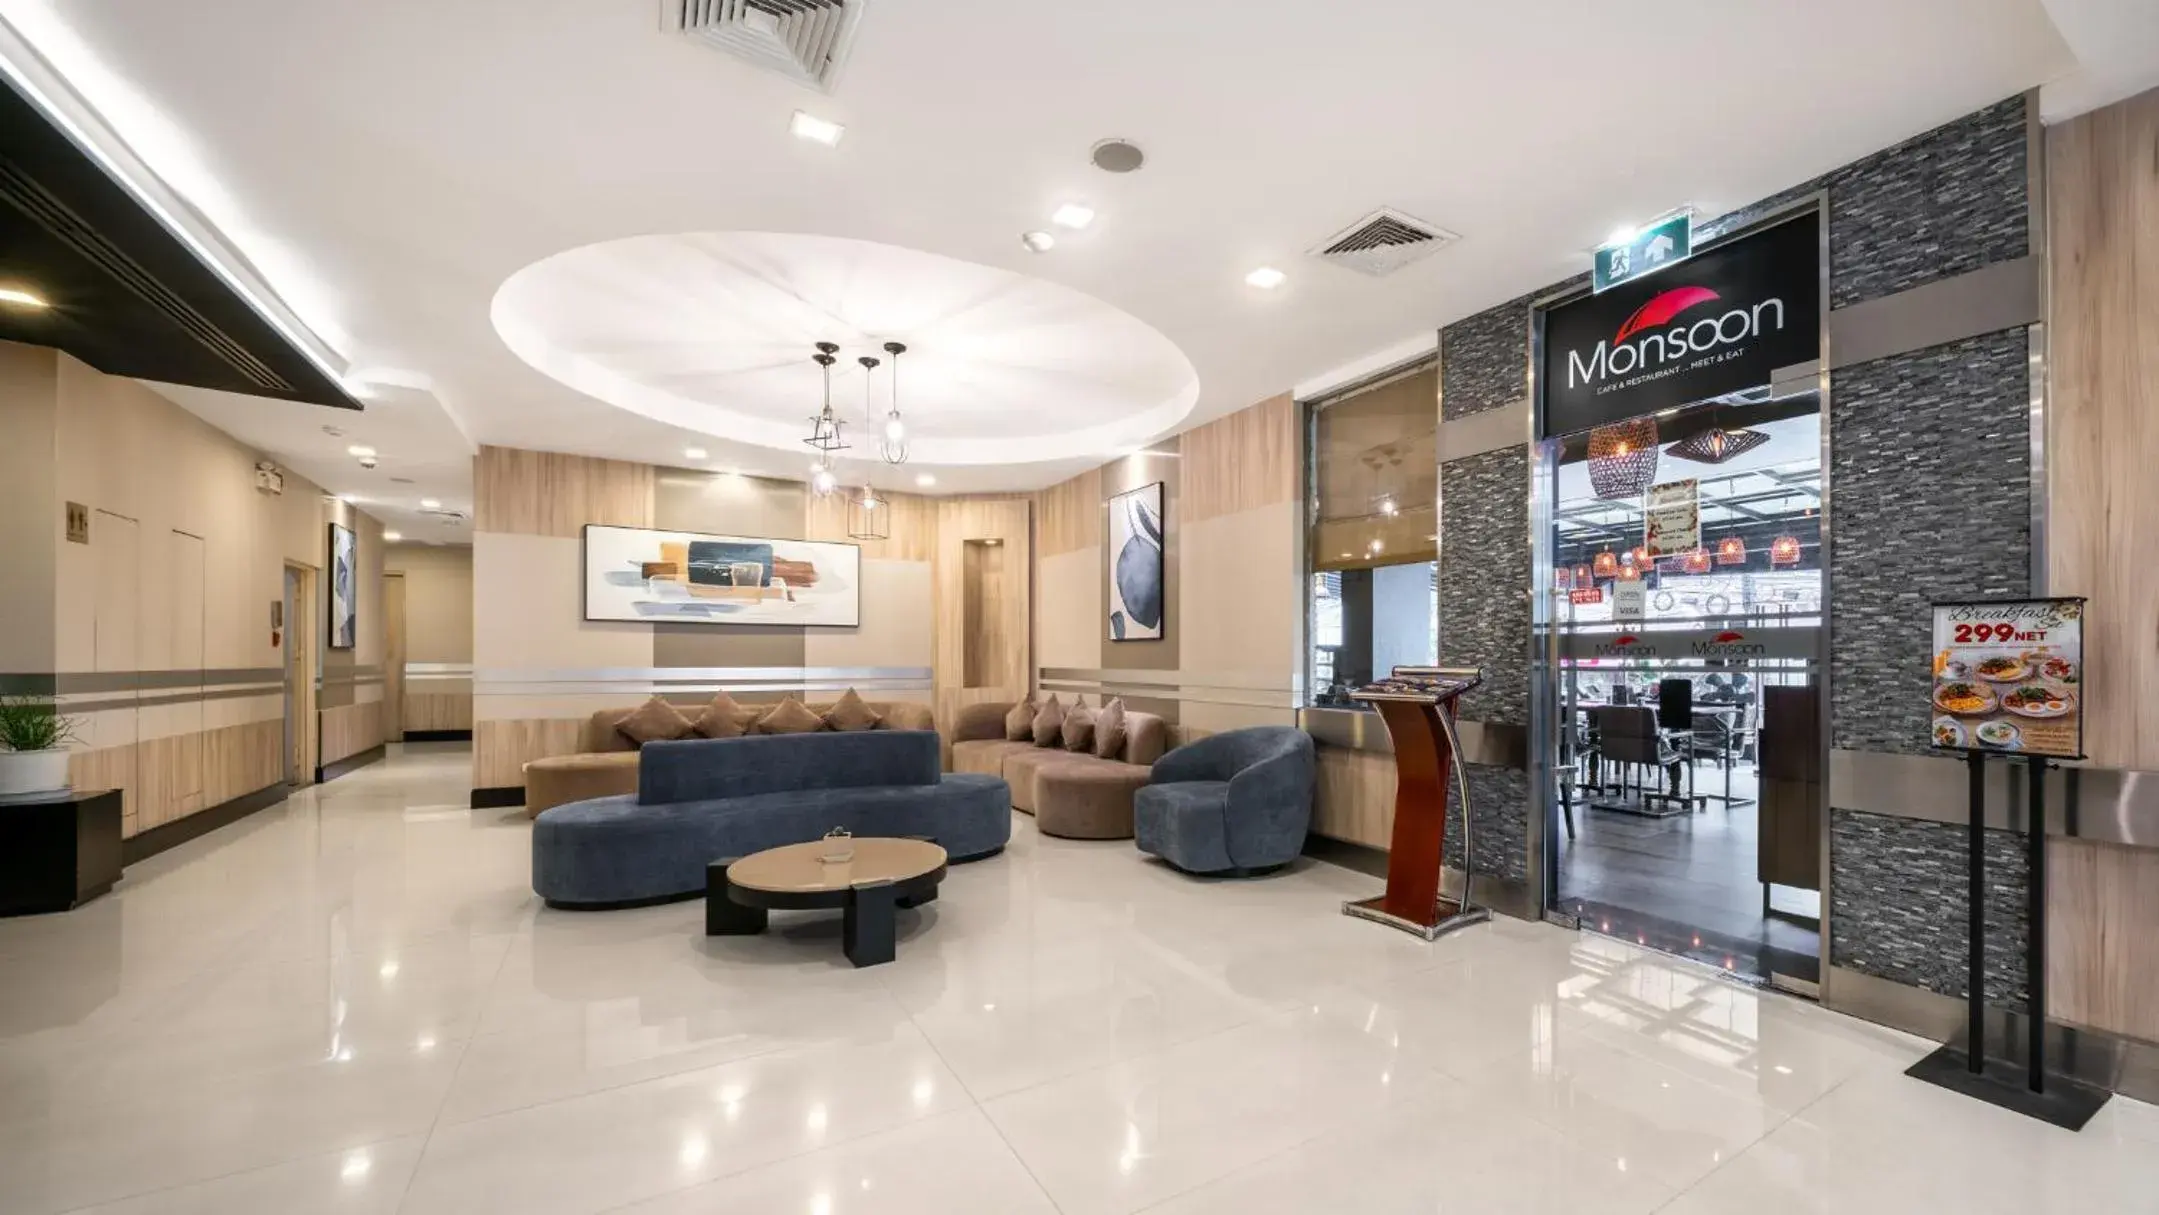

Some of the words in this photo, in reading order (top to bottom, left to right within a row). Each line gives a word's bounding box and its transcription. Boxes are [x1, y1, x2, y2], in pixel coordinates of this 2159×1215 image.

[1568, 297, 1784, 389] Monsoon
[1618, 381, 1625, 390] &
[1626, 366, 1680, 386] RESTAURANT
[1691, 356, 1715, 370] MEET
[1716, 354, 1724, 363] &
[1726, 348, 1744, 360] EAT
[1620, 607, 1640, 615] VISA
[1948, 605, 2057, 623] Breakfast
[1955, 623, 2014, 643] 299
[2015, 631, 2047, 641] NET
[1596, 643, 1657, 657] Monsoon
[1692, 641, 1765, 656] Monsoon
